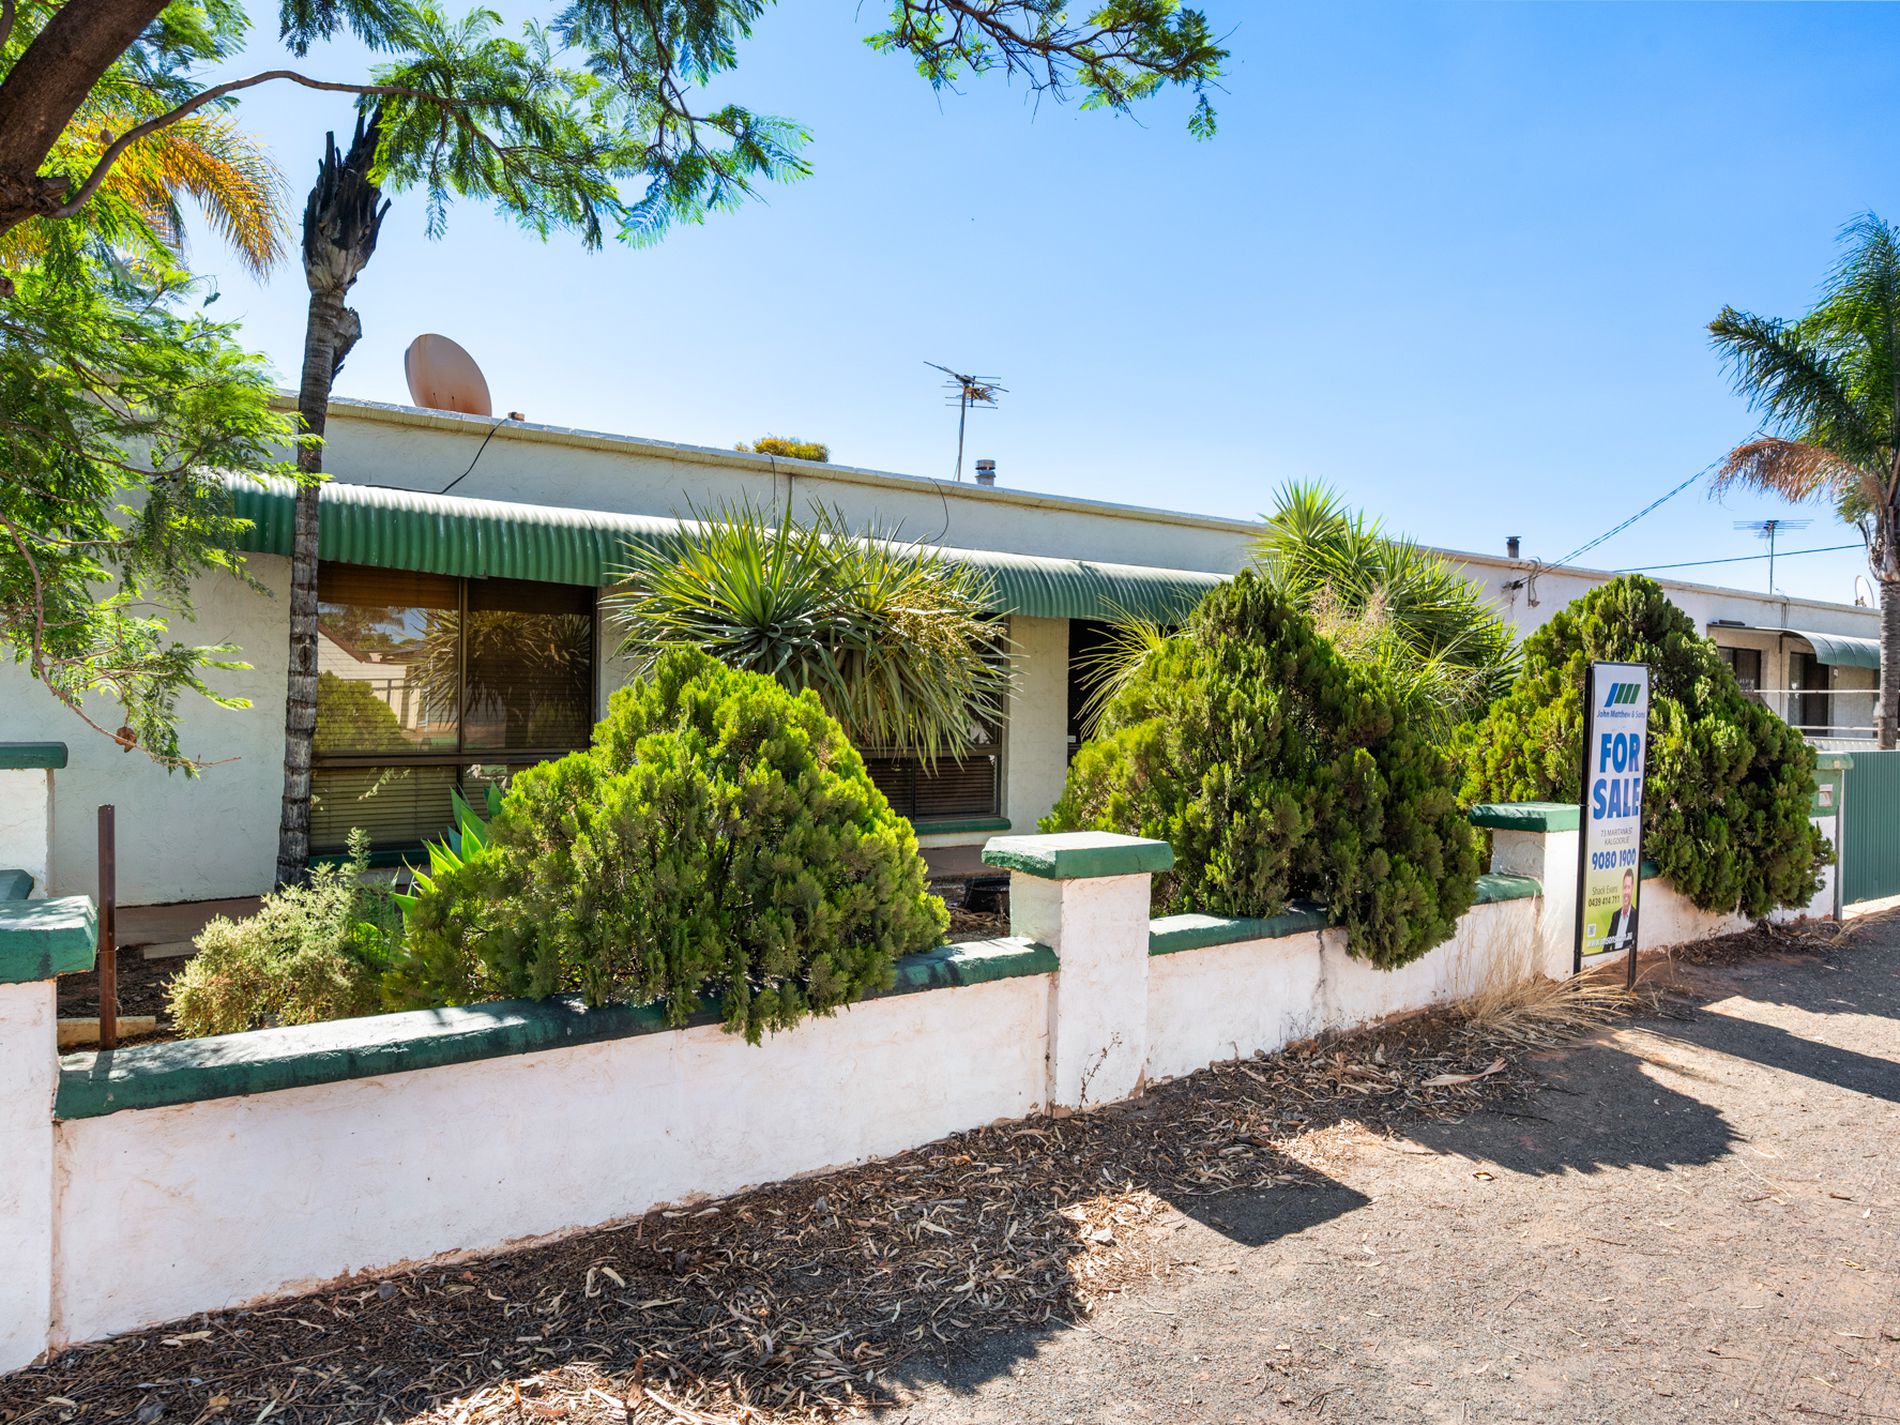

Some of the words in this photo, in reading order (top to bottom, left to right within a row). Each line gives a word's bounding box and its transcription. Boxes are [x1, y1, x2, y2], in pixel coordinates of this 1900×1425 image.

[1600, 732, 1641, 773] FOR
[1593, 778, 1641, 820] SALE
[1592, 850, 1617, 870] 9080
[1619, 847, 1637, 867] 1900
